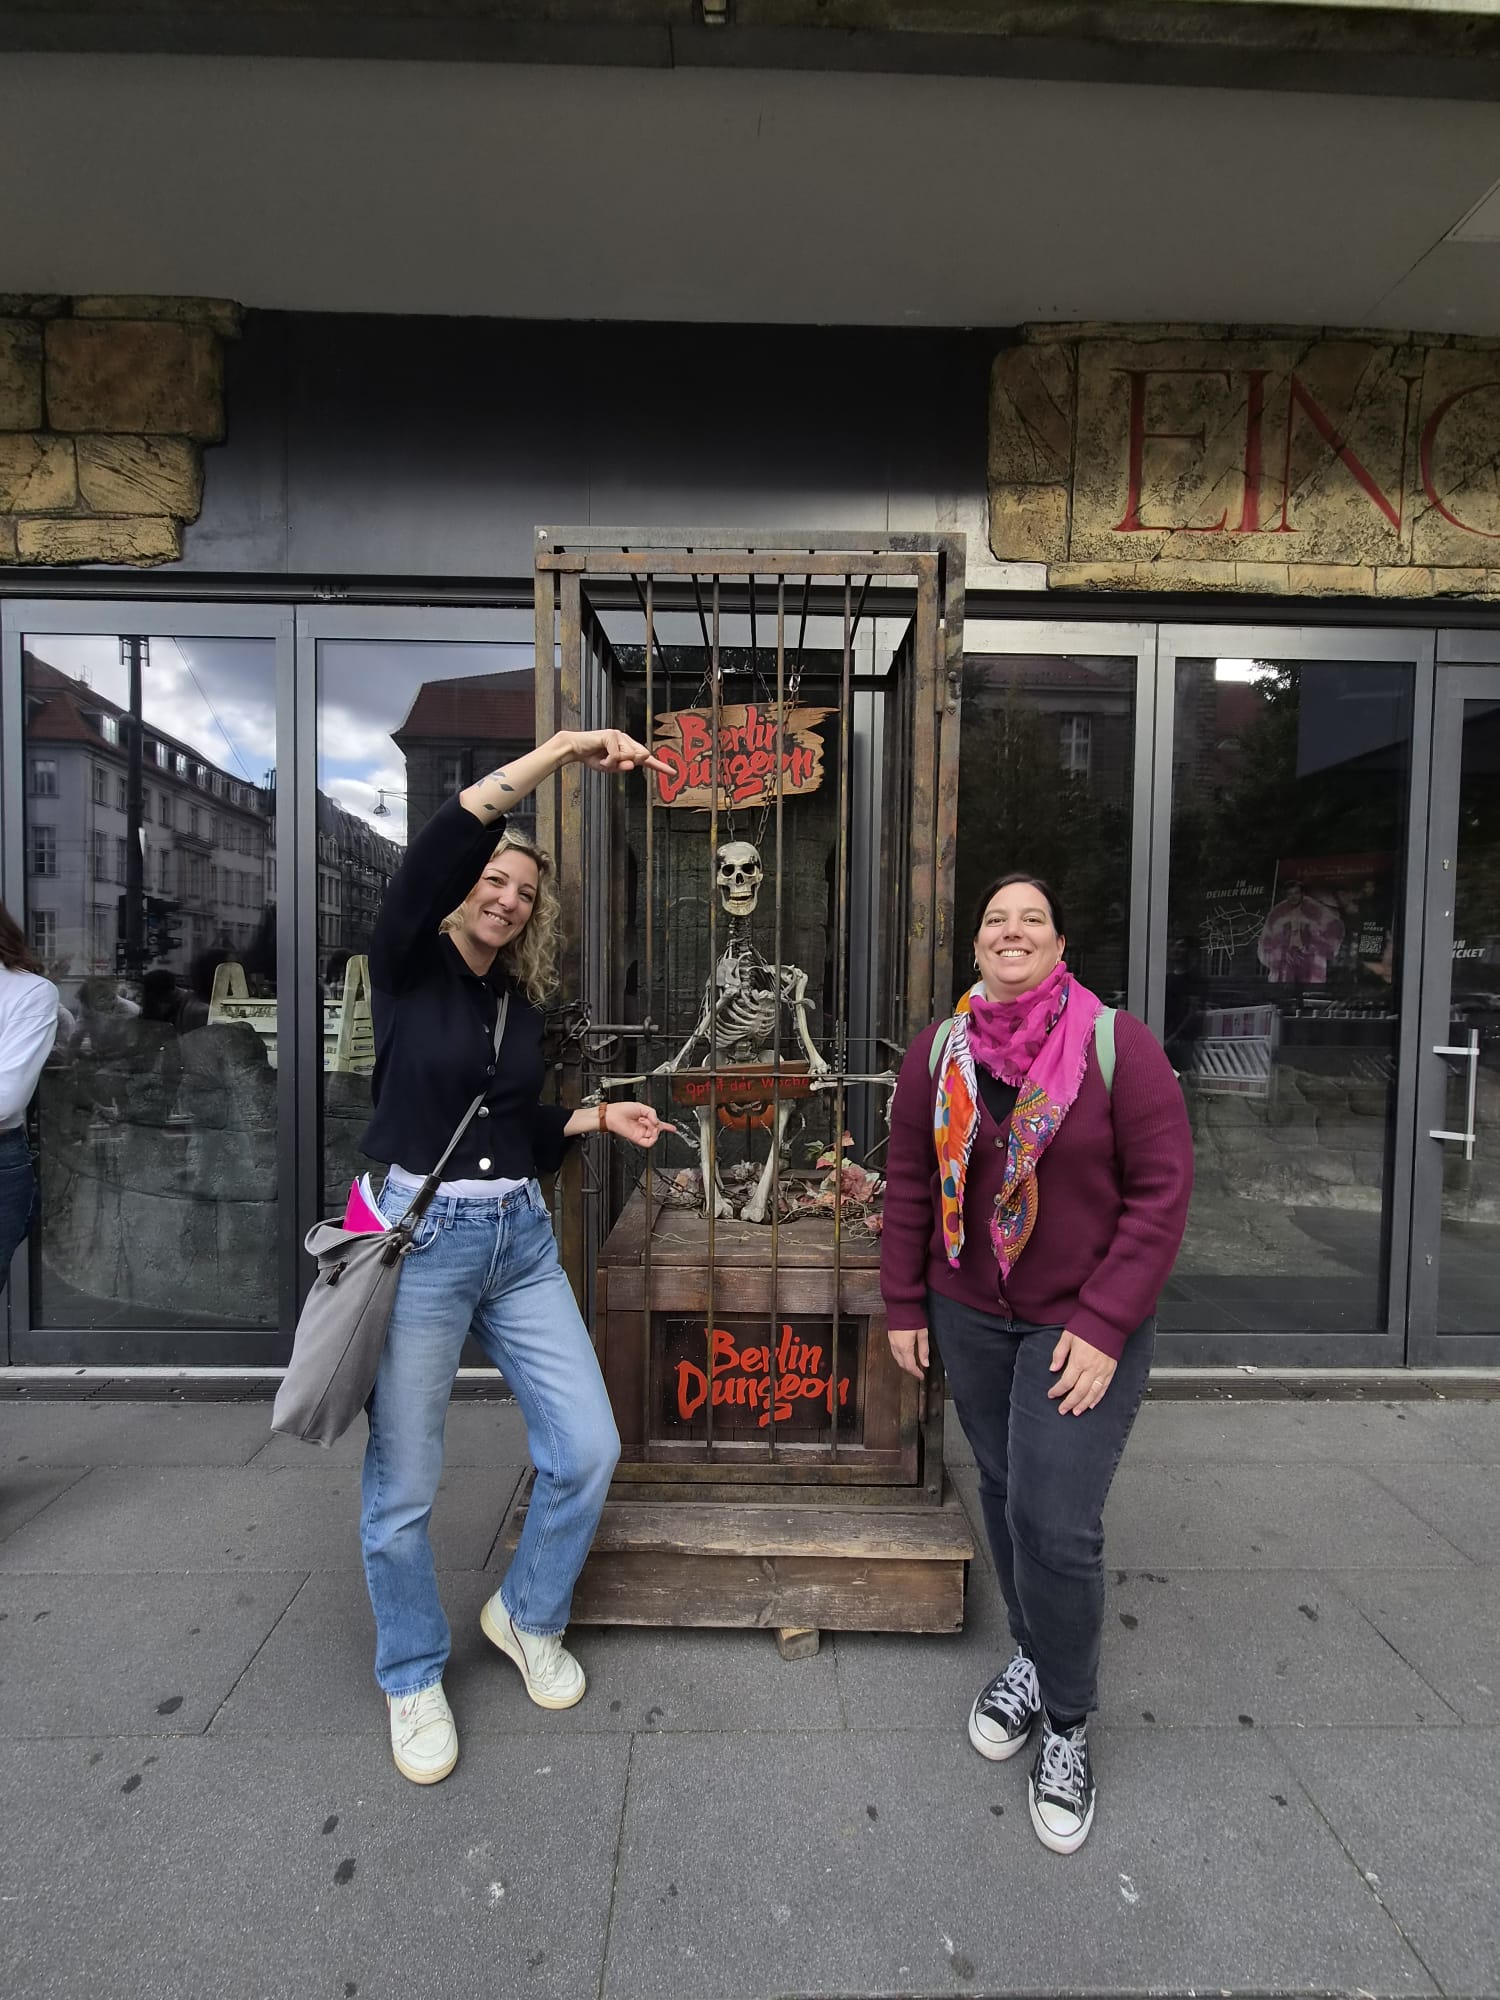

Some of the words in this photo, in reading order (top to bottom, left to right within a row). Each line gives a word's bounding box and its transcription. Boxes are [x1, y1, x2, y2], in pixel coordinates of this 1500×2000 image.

[676, 705, 786, 762] Berlin
[656, 746, 815, 804] Dungeon
[1205, 888, 1239, 899] DEINER
[1451, 947, 1486, 959] ICKET
[730, 1078, 753, 1092] der
[761, 1076, 811, 1090] Wche
[704, 1325, 823, 1376] Berlin
[674, 1360, 850, 1428] Dungeon
